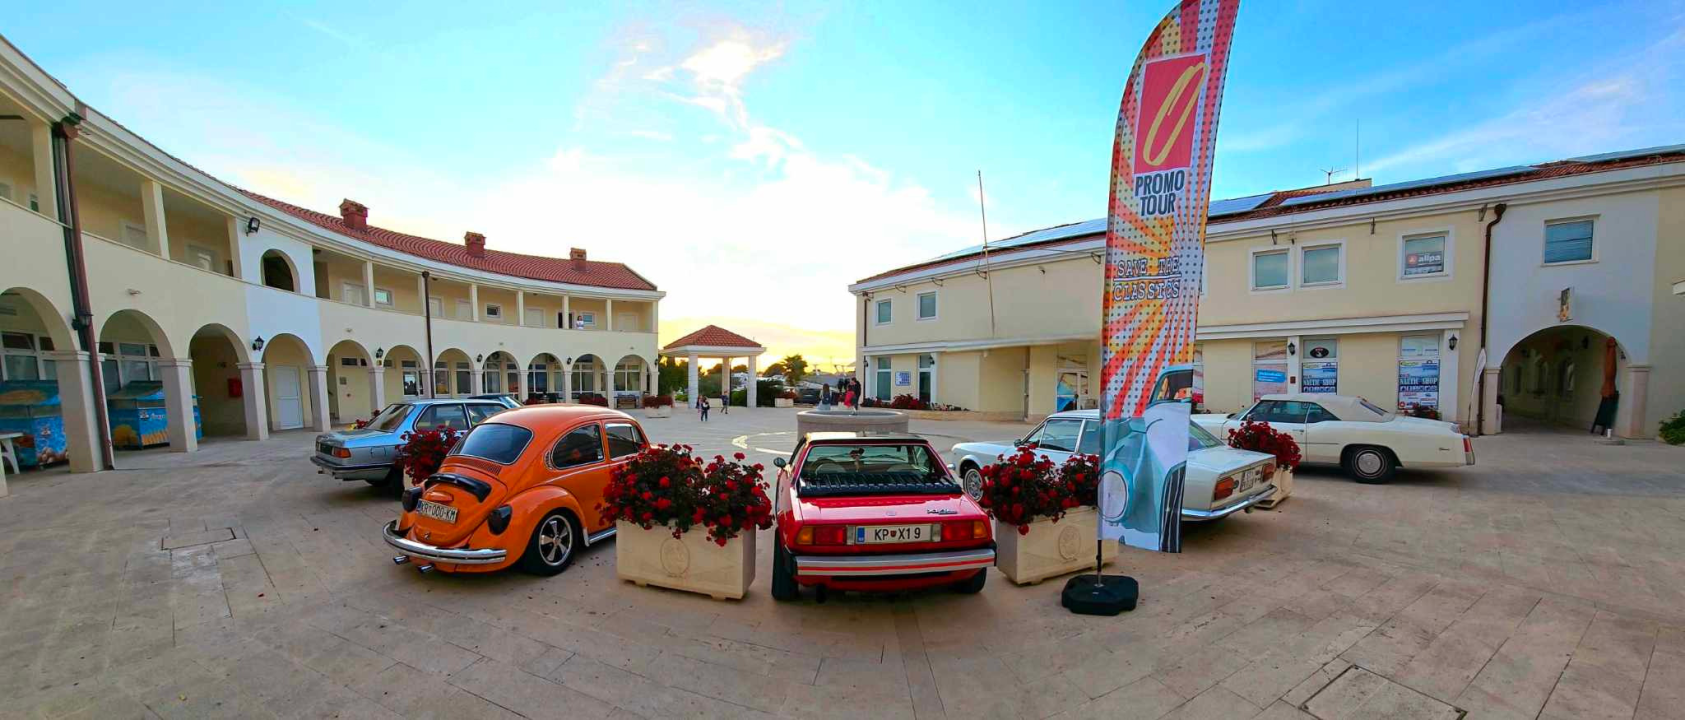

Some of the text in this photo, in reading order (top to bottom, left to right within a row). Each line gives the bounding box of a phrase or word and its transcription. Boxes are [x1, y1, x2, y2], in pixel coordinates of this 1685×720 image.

[1135, 170, 1185, 197] PROMO
[1140, 193, 1176, 216] TOUR
[1117, 256, 1179, 276] SAVE THE
[1113, 281, 1180, 301] CLASSICS
[874, 528, 889, 541] KP
